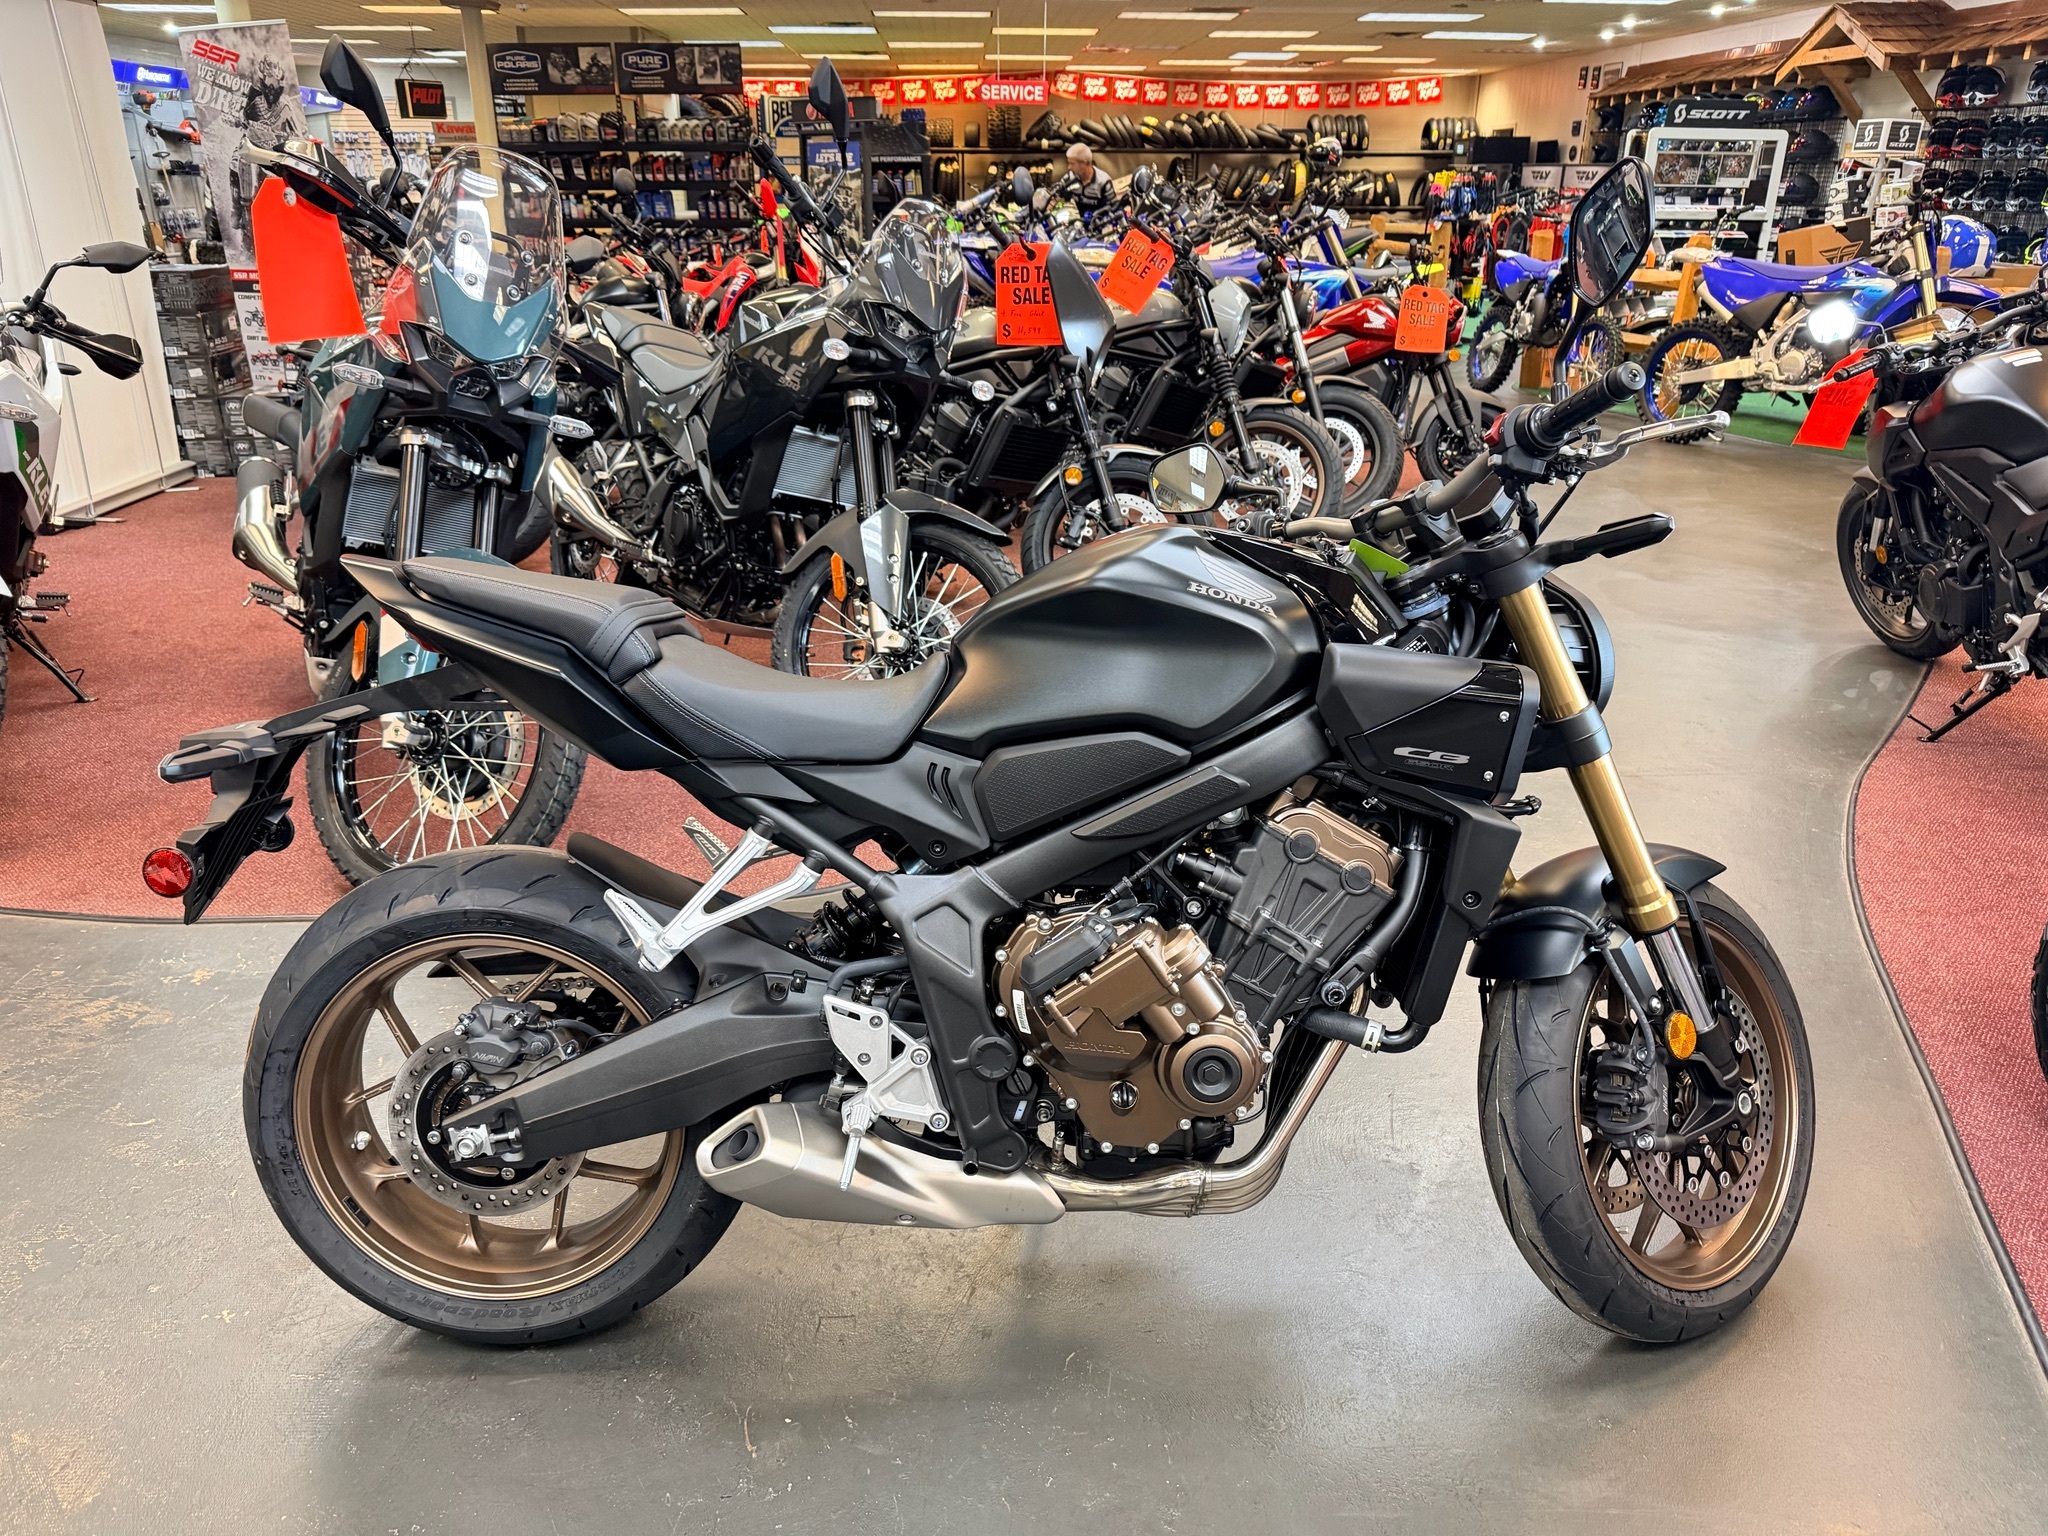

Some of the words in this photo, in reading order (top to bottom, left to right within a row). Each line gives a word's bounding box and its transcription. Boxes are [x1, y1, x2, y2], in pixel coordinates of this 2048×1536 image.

[191, 39, 240, 74] SSR
[628, 55, 663, 64] PURE
[198, 63, 215, 80] WE
[215, 72, 252, 96] KNOW
[1055, 72, 1075, 82] RIDE
[1084, 77, 1105, 87] RIDE
[872, 80, 891, 91] RIDE
[902, 80, 922, 90] RIDE
[933, 78, 953, 89] RIDE
[1056, 80, 1076, 93] RED
[1114, 79, 1135, 89] RIDE
[1144, 82, 1166, 92] RIDE
[1175, 83, 1196, 93] RIDE
[1206, 85, 1226, 94] RIDE
[1236, 84, 1256, 93] RIDE
[1296, 84, 1317, 93] RIDE
[1327, 84, 1347, 93] RIDE
[1357, 82, 1377, 92] RIDE
[1387, 81, 1408, 91] RIDE
[1417, 79, 1437, 90] RIDE
[412, 87, 442, 104] PILOT
[905, 89, 926, 101] RED
[935, 88, 957, 100] RED
[981, 85, 1044, 100] SERVICE
[1086, 85, 1107, 97] RED
[1116, 87, 1137, 100] RED
[1146, 90, 1167, 102] RED
[1266, 85, 1286, 95] RIDE
[1420, 88, 1440, 101] RED
[195, 81, 249, 118] DIRT
[1176, 91, 1198, 103] RED
[1207, 93, 1228, 105] RED
[1237, 93, 1259, 106] RED
[1267, 94, 1289, 107] RED
[1298, 93, 1319, 106] RED
[1328, 92, 1350, 105] RED
[1359, 91, 1380, 104] RED
[1389, 90, 1410, 103] RED
[1687, 109, 1751, 120] SCOTT
[1531, 170, 1551, 180] FLY
[1575, 170, 1598, 181] FLY
[1123, 236, 1146, 257] RED
[1145, 247, 1168, 272] TAG
[1121, 255, 1151, 280] SALE
[1000, 266, 1030, 283] RED
[1013, 287, 1050, 305] SALE
[1404, 298, 1423, 312] RED
[1426, 301, 1445, 314] TAG
[1409, 313, 1436, 326] SALE
[753, 345, 807, 383] KLE
[1186, 581, 1278, 619] HONDA
[1393, 746, 1470, 764] CB
[402, 1290, 542, 1320] Roadsport
